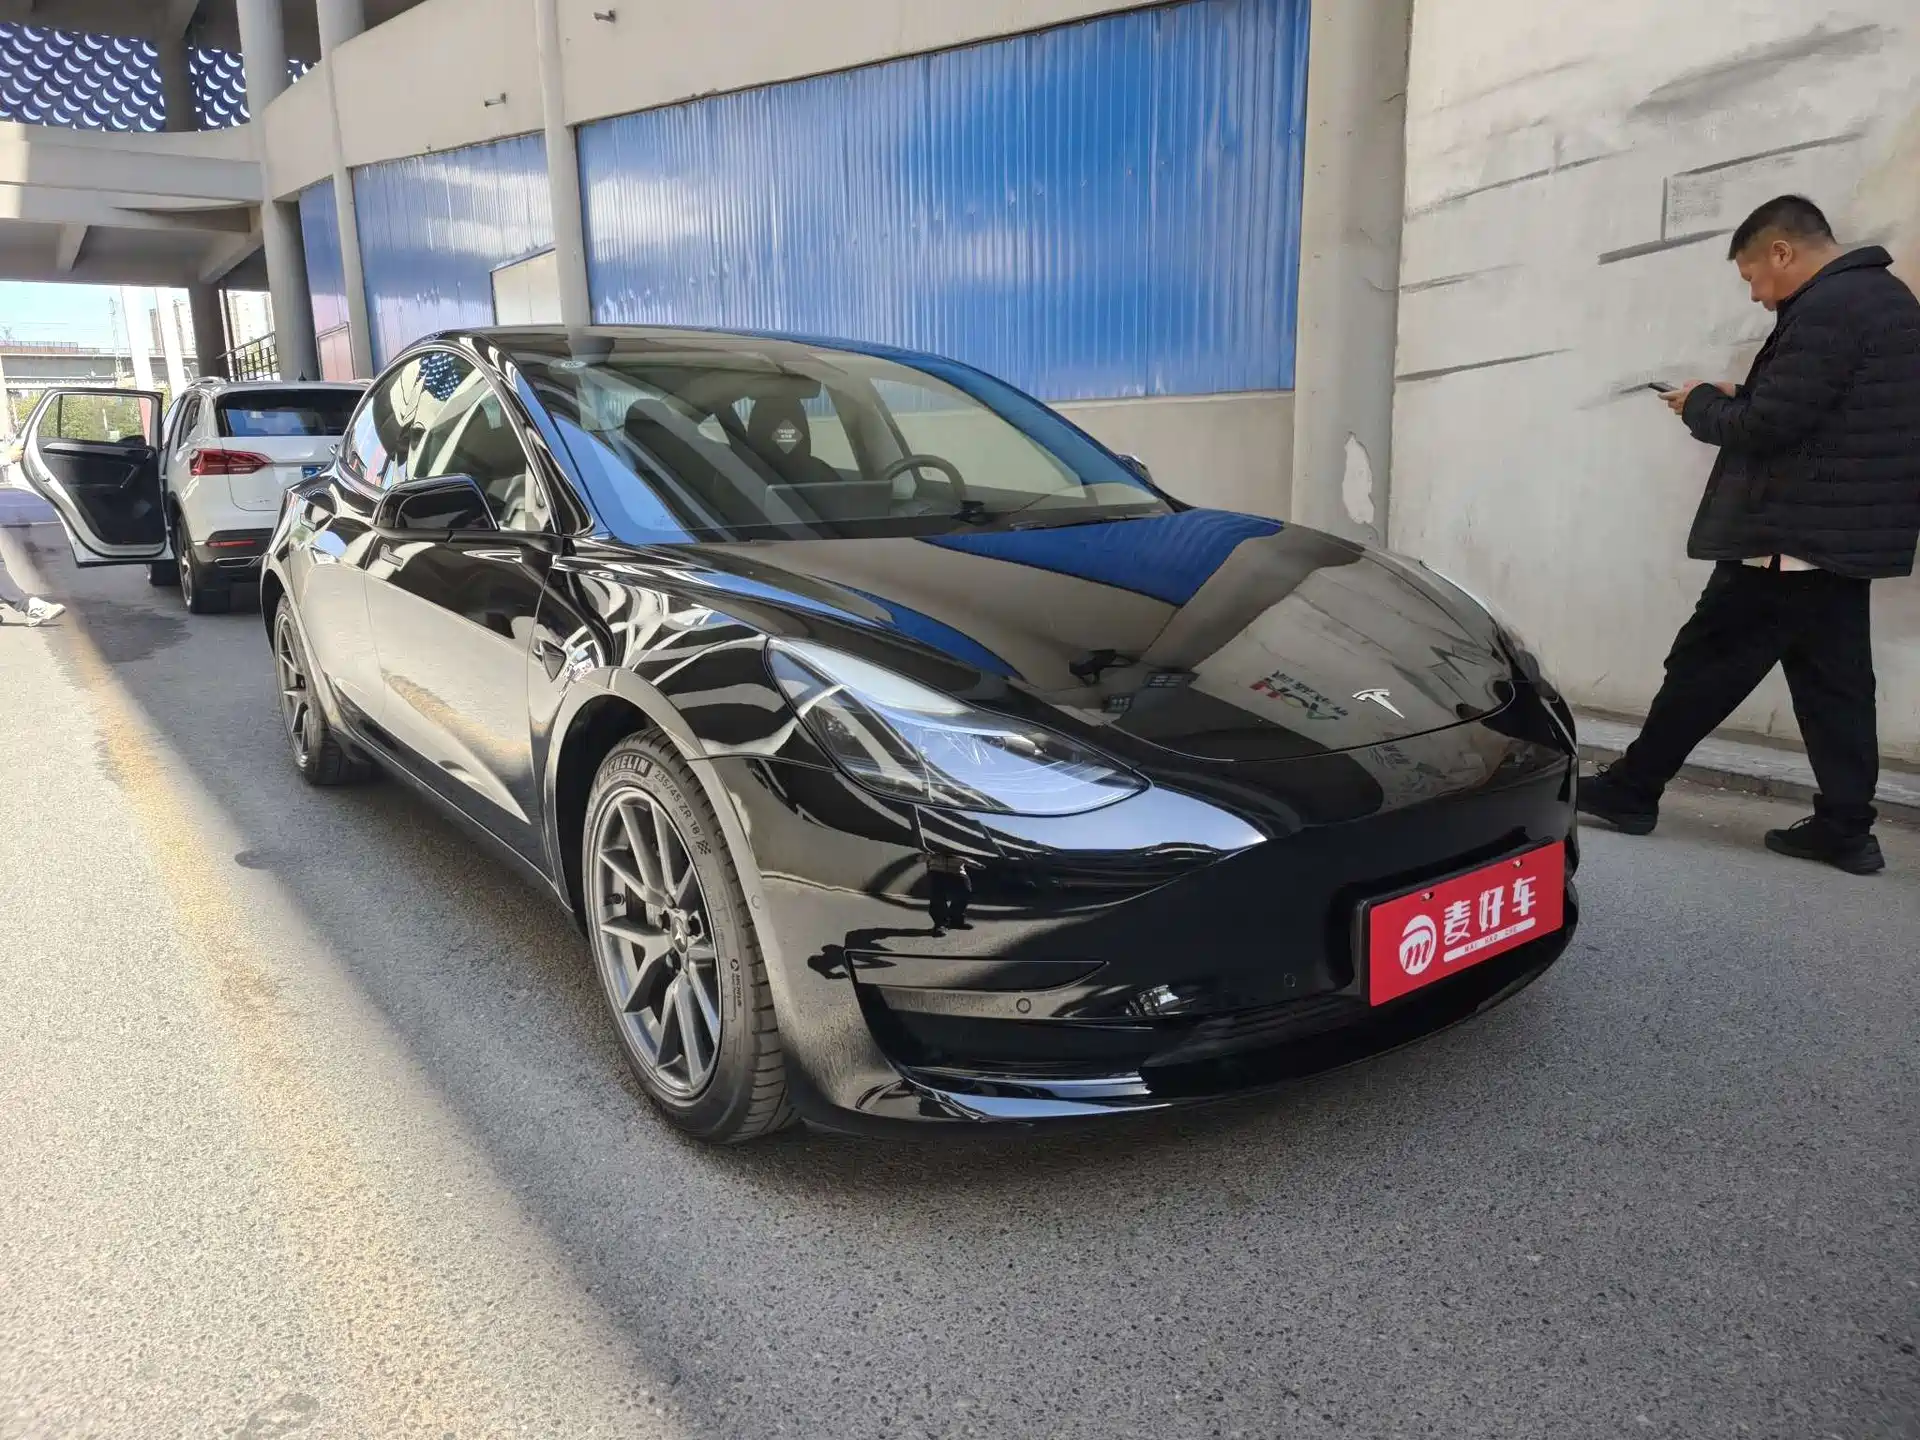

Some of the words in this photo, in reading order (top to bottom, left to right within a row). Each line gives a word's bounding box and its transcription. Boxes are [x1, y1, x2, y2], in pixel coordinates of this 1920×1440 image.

[654, 770, 682, 801] 235/45
[679, 804, 692, 818] ZR
[1443, 876, 1537, 946] 麦好车
